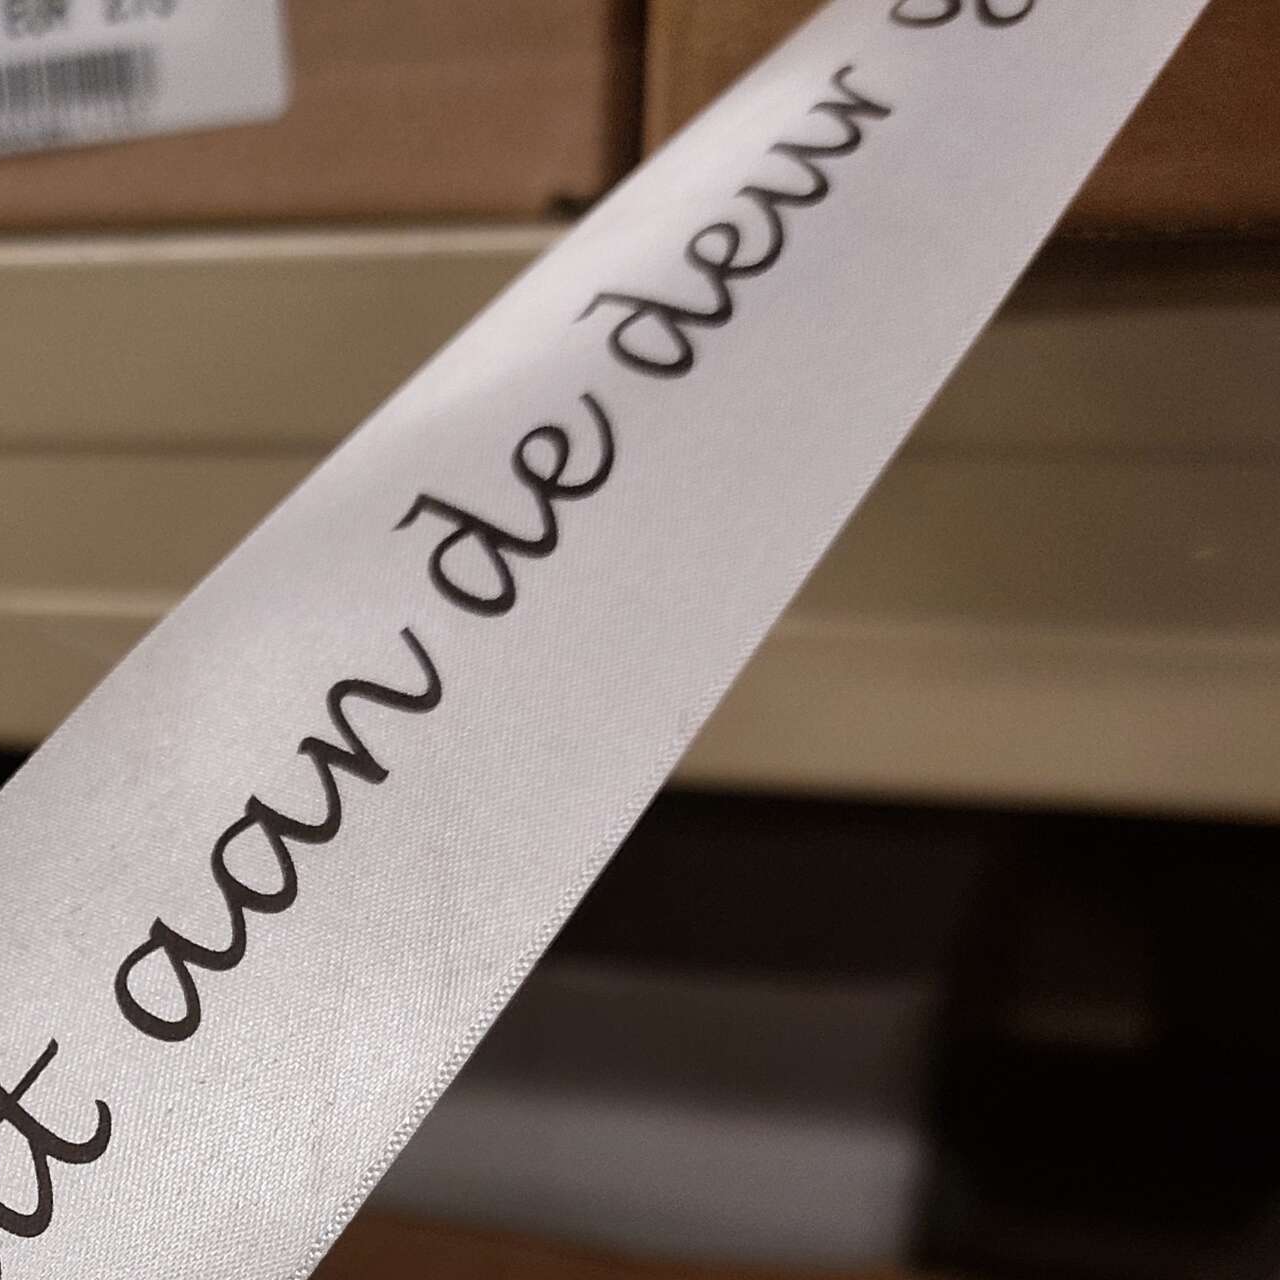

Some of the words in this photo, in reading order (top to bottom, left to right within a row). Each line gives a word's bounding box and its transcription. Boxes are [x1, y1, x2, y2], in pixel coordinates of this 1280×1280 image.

[114, 627, 443, 1043] aan
[397, 393, 616, 617] de
[609, 64, 892, 378] deur
